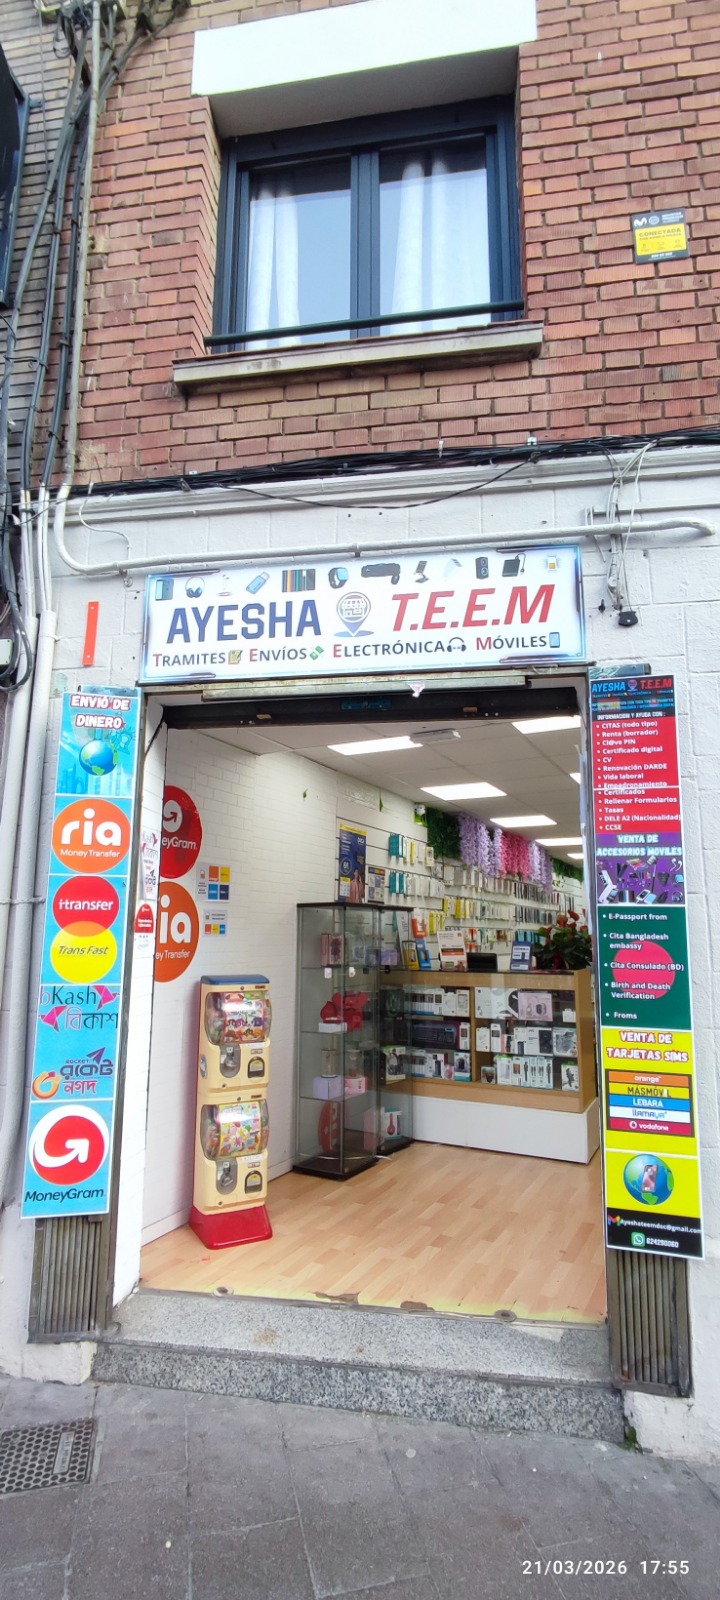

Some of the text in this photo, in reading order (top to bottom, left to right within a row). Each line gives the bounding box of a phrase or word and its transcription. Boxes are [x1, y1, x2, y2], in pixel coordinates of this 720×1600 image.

[166, 584, 556, 644] AYESHA T.E.E.M
[153, 633, 547, 667] TRAMITES ENVÍOS ELECTRÓNICA MÓVILES
[592, 678, 672, 692] AYESHA T.E.E.M
[112, 699, 131, 711] DE
[76, 714, 122, 729] DINERO
[621, 721, 640, 729] (todo
[641, 720, 658, 729] tipo)
[602, 745, 663, 755] Certificado digital
[603, 764, 643, 772] Renovación
[634, 795, 677, 804] Formularios
[632, 814, 681, 822] (Nacionalidad)
[61, 807, 122, 847] ria
[161, 836, 196, 850] eyGram
[617, 834, 659, 843] VENTA DE
[60, 849, 121, 858] Money Transfer
[597, 847, 645, 856] ACCESORIOS
[160, 894, 192, 944] ia
[608, 913, 648, 921] E-Passport
[625, 932, 669, 941] Bangladesh
[58, 945, 109, 955] Trans Fast
[609, 942, 642, 950] embassy
[164, 949, 191, 959] Transfer
[626, 962, 667, 970] Consulado
[667, 963, 685, 971] (BD)
[647, 982, 671, 990] Death
[40, 985, 97, 1006] bKash
[611, 991, 656, 999] Verification
[65, 1006, 119, 1030] বিকাশ
[614, 1011, 637, 1019] Froms
[620, 1031, 673, 1044] VENTA DE
[606, 1048, 689, 1062] TARJETAS SIMS
[60, 1058, 114, 1081] রকেট
[634, 1075, 660, 1083] orange
[62, 1080, 98, 1095] নগদ
[632, 1098, 664, 1108] LEBARA
[639, 1122, 669, 1131] vodafone
[24, 1188, 105, 1203] MoneyGram
